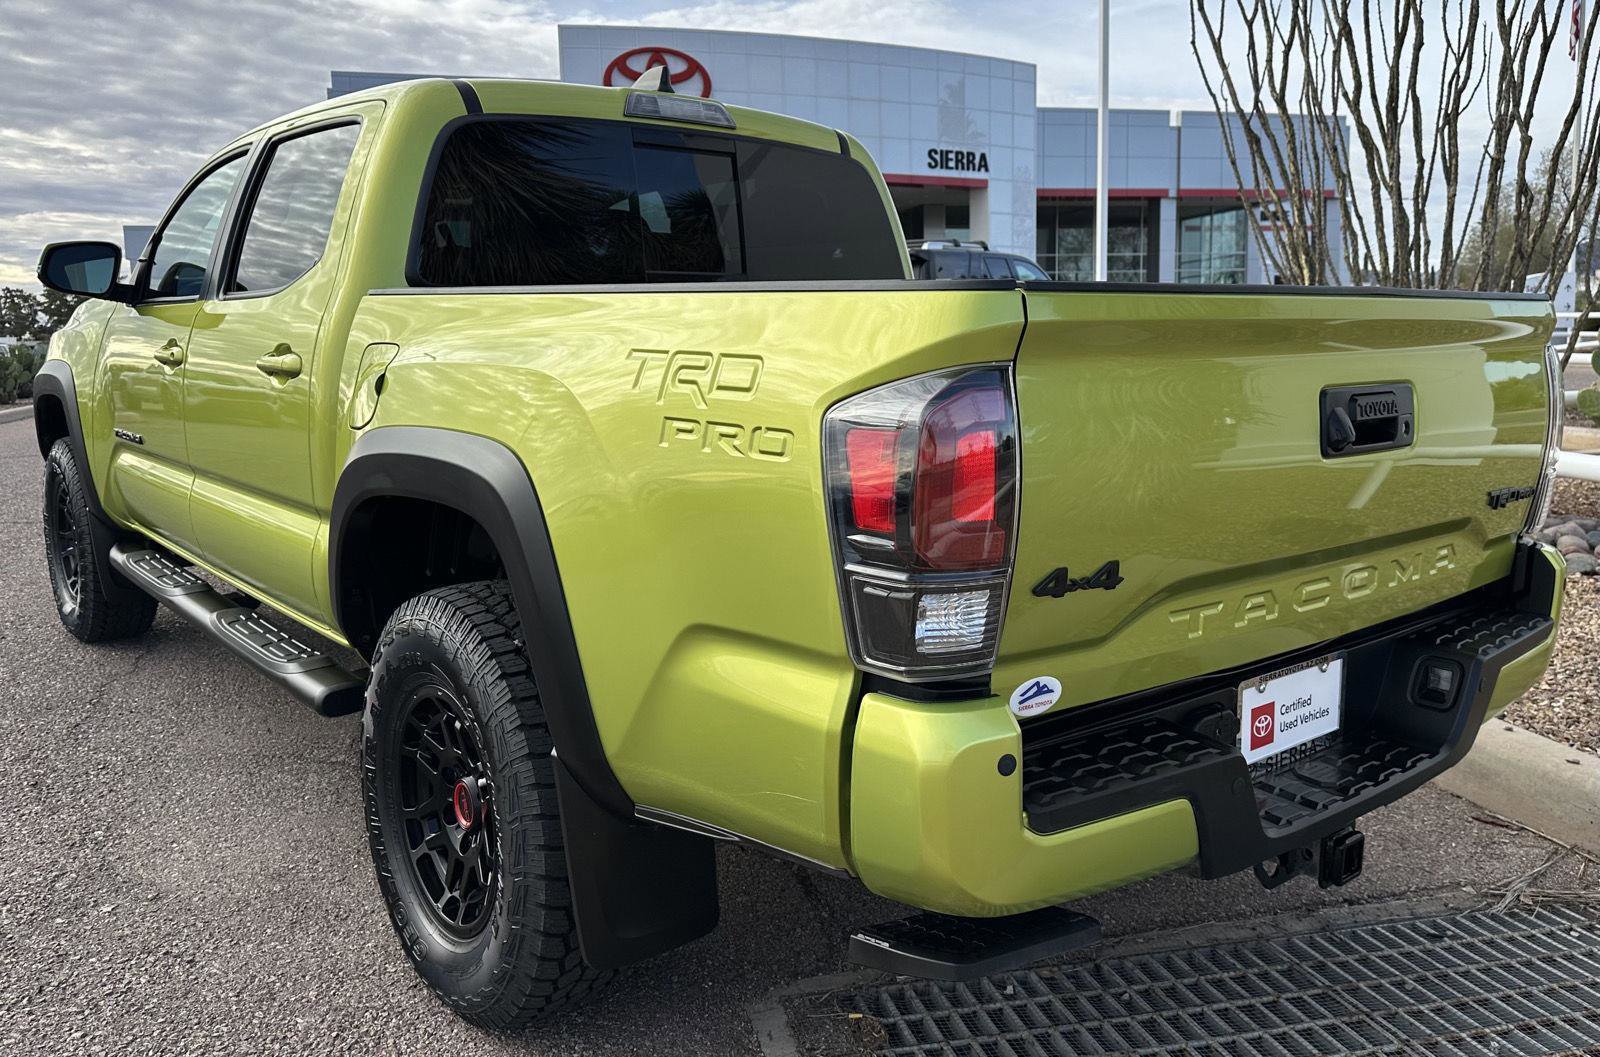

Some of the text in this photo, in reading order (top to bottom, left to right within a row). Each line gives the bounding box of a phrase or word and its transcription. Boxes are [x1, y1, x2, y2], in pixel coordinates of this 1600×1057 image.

[927, 148, 990, 173] SIERRA
[625, 348, 765, 410] TRD
[1357, 399, 1400, 418] TOYOTA
[658, 415, 796, 464] PRO
[1168, 543, 1457, 640] TACOMA
[1279, 694, 1312, 716] Certified
[1279, 706, 1330, 733] Used Vehicles
[1265, 739, 1317, 773] SIERRA
